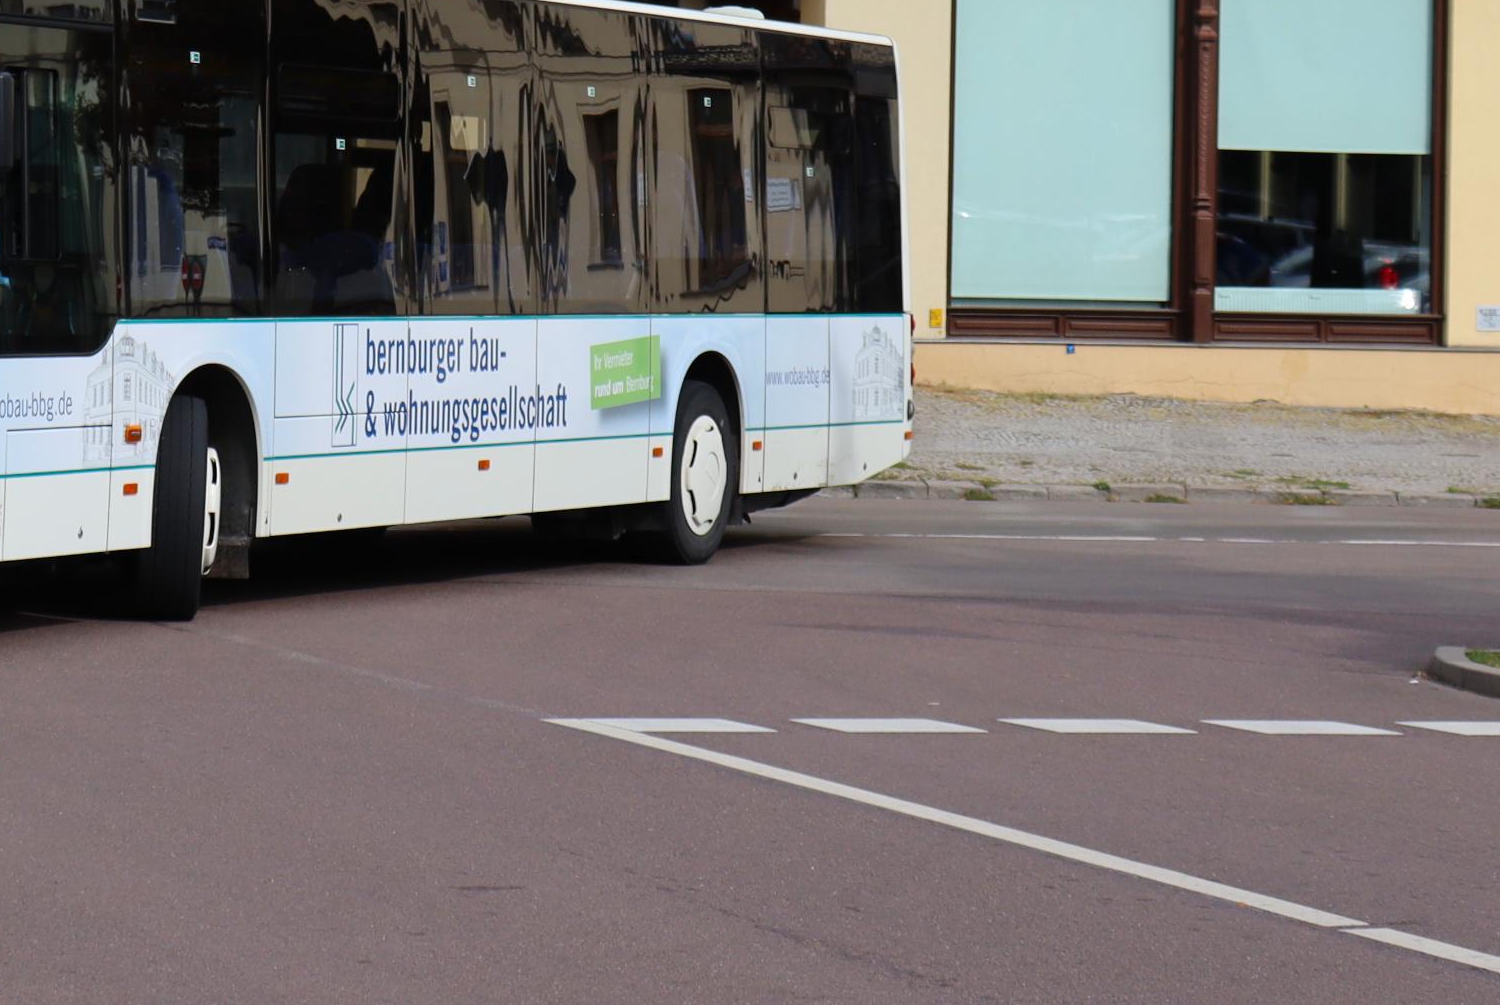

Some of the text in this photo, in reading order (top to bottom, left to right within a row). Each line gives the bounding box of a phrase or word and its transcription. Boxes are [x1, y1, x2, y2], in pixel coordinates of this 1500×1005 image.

[366, 327, 507, 383] bernburger bau-
[365, 383, 568, 443] & wohnungsgesellschaft
[594, 379, 612, 398] rund
[612, 381, 624, 396] um
